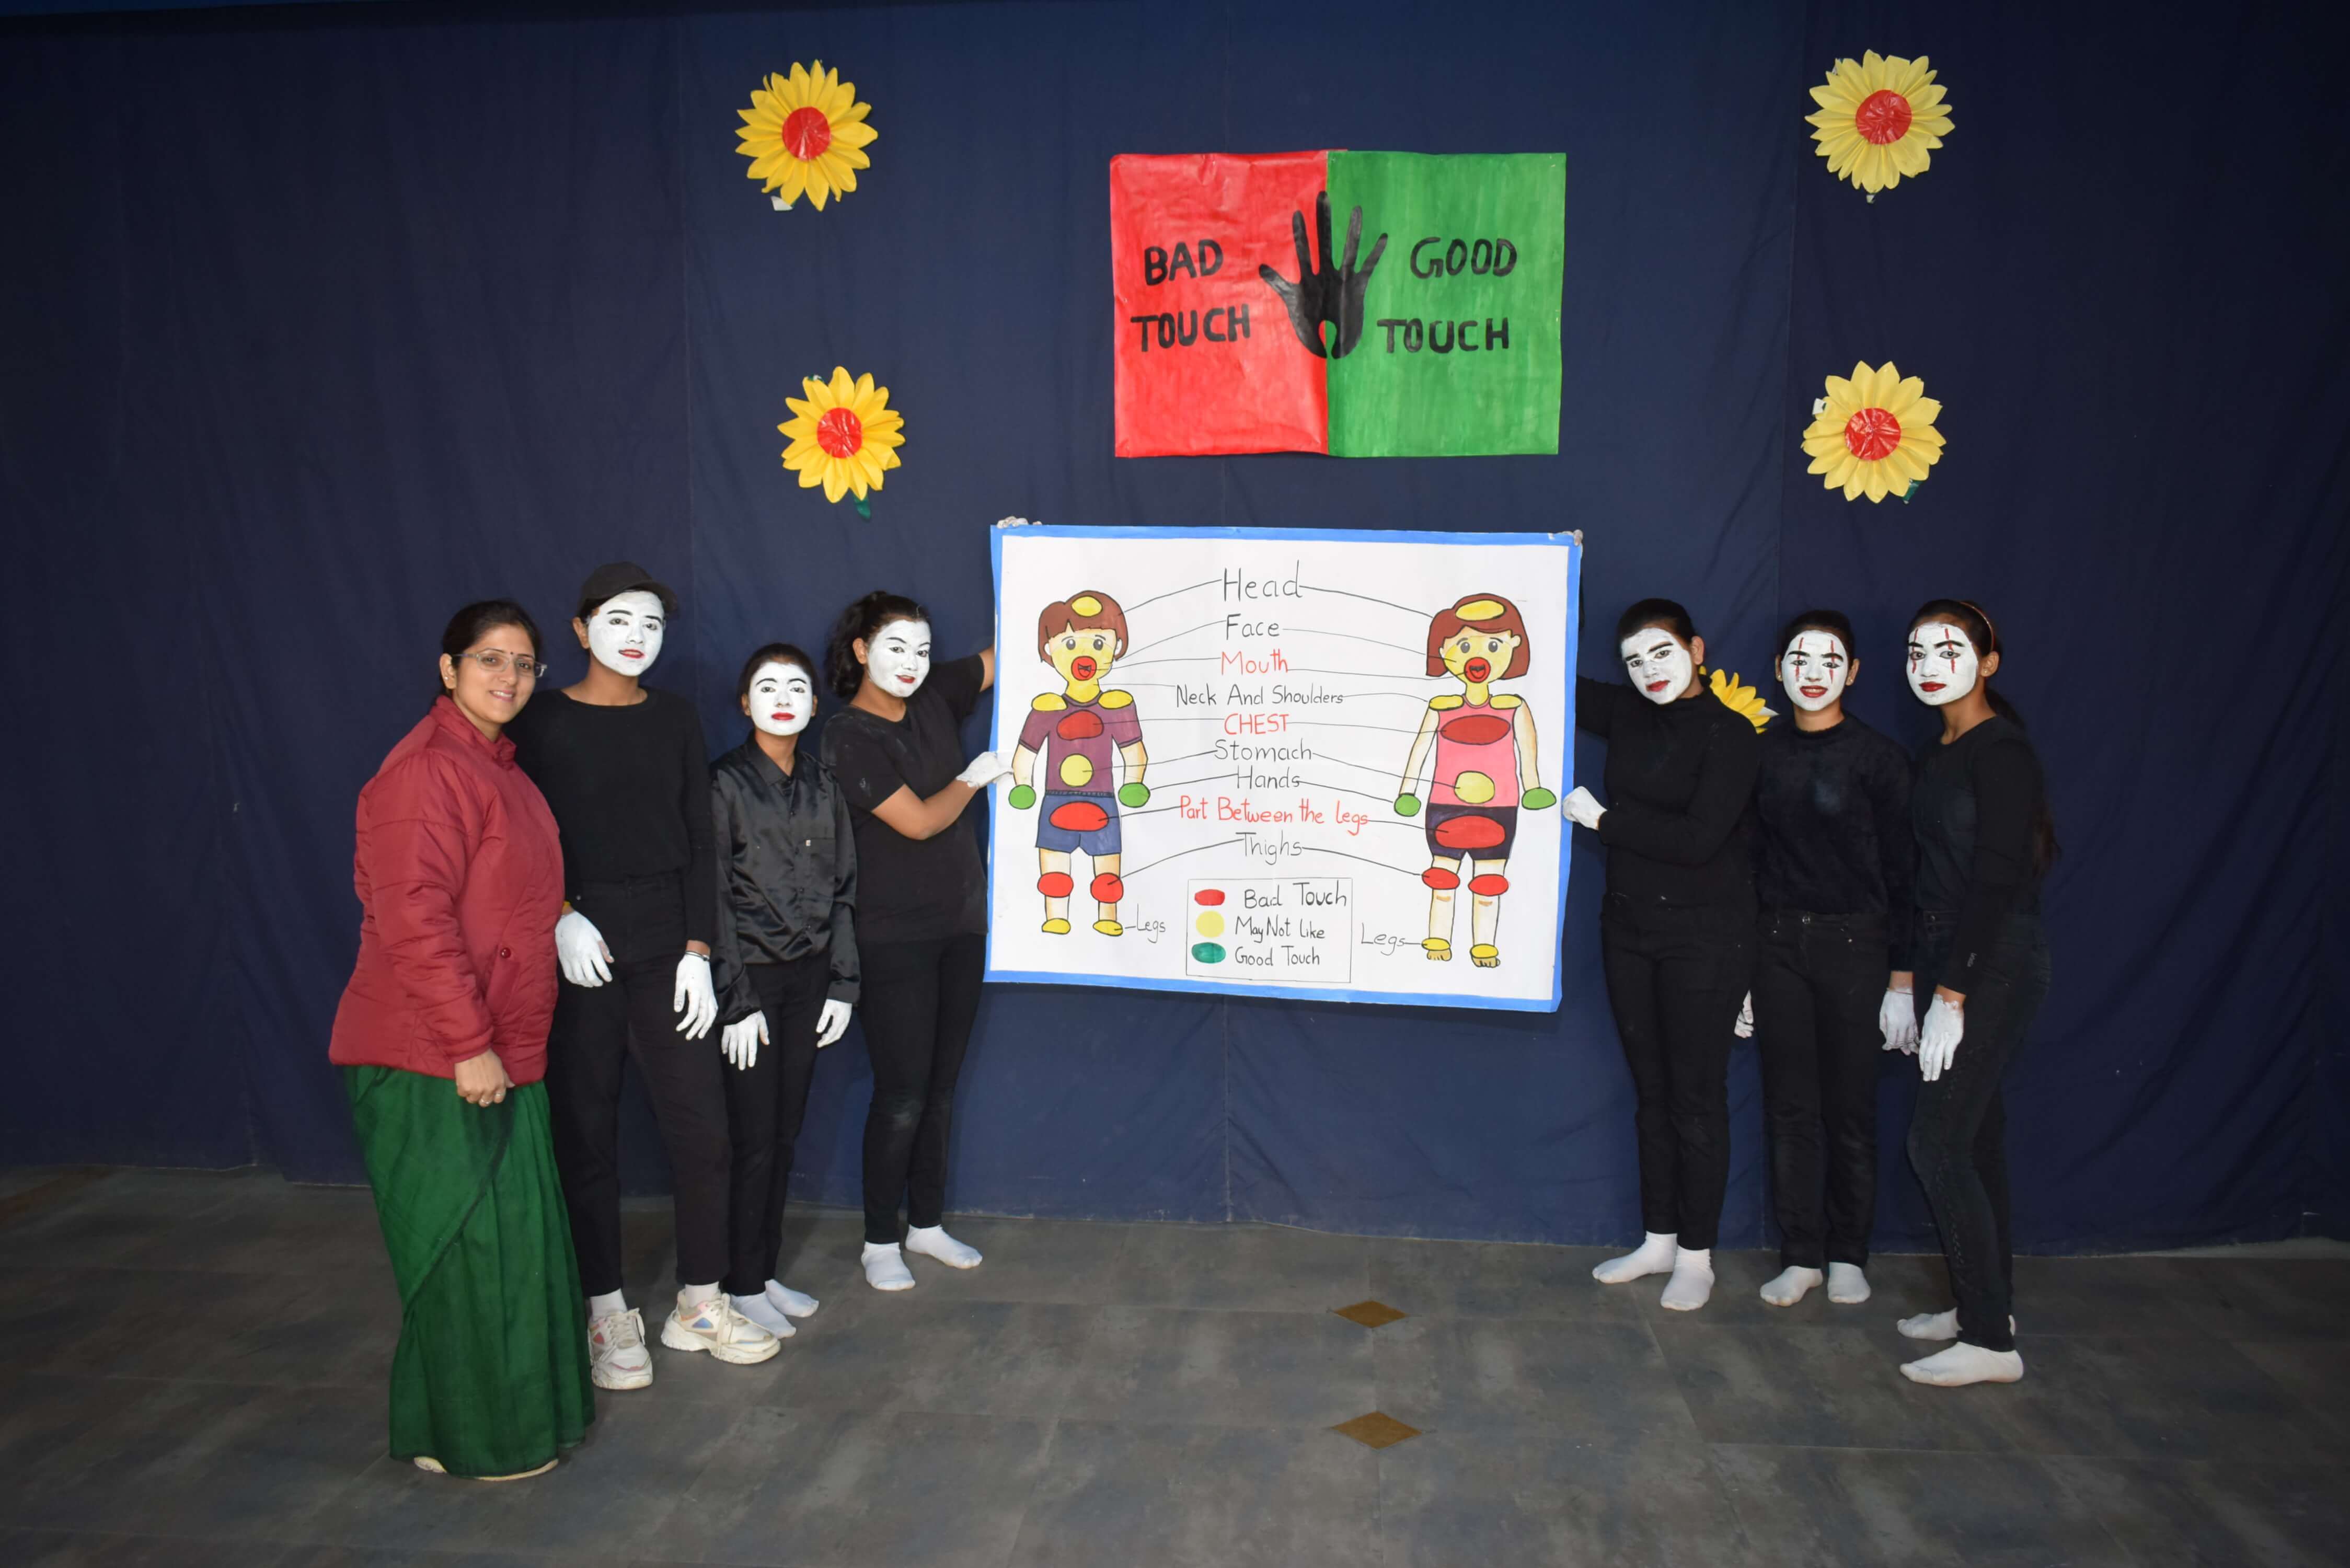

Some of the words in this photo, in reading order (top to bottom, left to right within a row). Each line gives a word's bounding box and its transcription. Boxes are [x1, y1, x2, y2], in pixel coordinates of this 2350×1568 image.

[1144, 239, 1223, 286] BAD
[1411, 236, 1517, 279] GOOD
[1130, 303, 1251, 353] TOUCH
[1377, 318, 1510, 354] TOUCH
[1224, 559, 1303, 602] Head
[1226, 613, 1280, 640] Face
[1221, 648, 1289, 676] Mouth
[1177, 683, 1217, 708] Neck
[1227, 684, 1263, 706] And
[1272, 682, 1344, 704] Shoulders
[1224, 713, 1289, 735] CHEST
[1214, 737, 1312, 763] Stomach
[1237, 765, 1301, 790] Hands
[1180, 795, 1209, 820] Part
[1217, 797, 1293, 824] Between
[1298, 798, 1325, 824] the
[1235, 829, 1303, 866] Thighs
[1244, 884, 1283, 909] Bad
[1293, 880, 1347, 907] Touch
[1136, 903, 1166, 943] Legs
[1235, 915, 1264, 944] May
[1266, 914, 1292, 937] Not
[1361, 923, 1406, 956] Legs
[1235, 946, 1274, 967] Good
[1281, 945, 1320, 966] Touch
